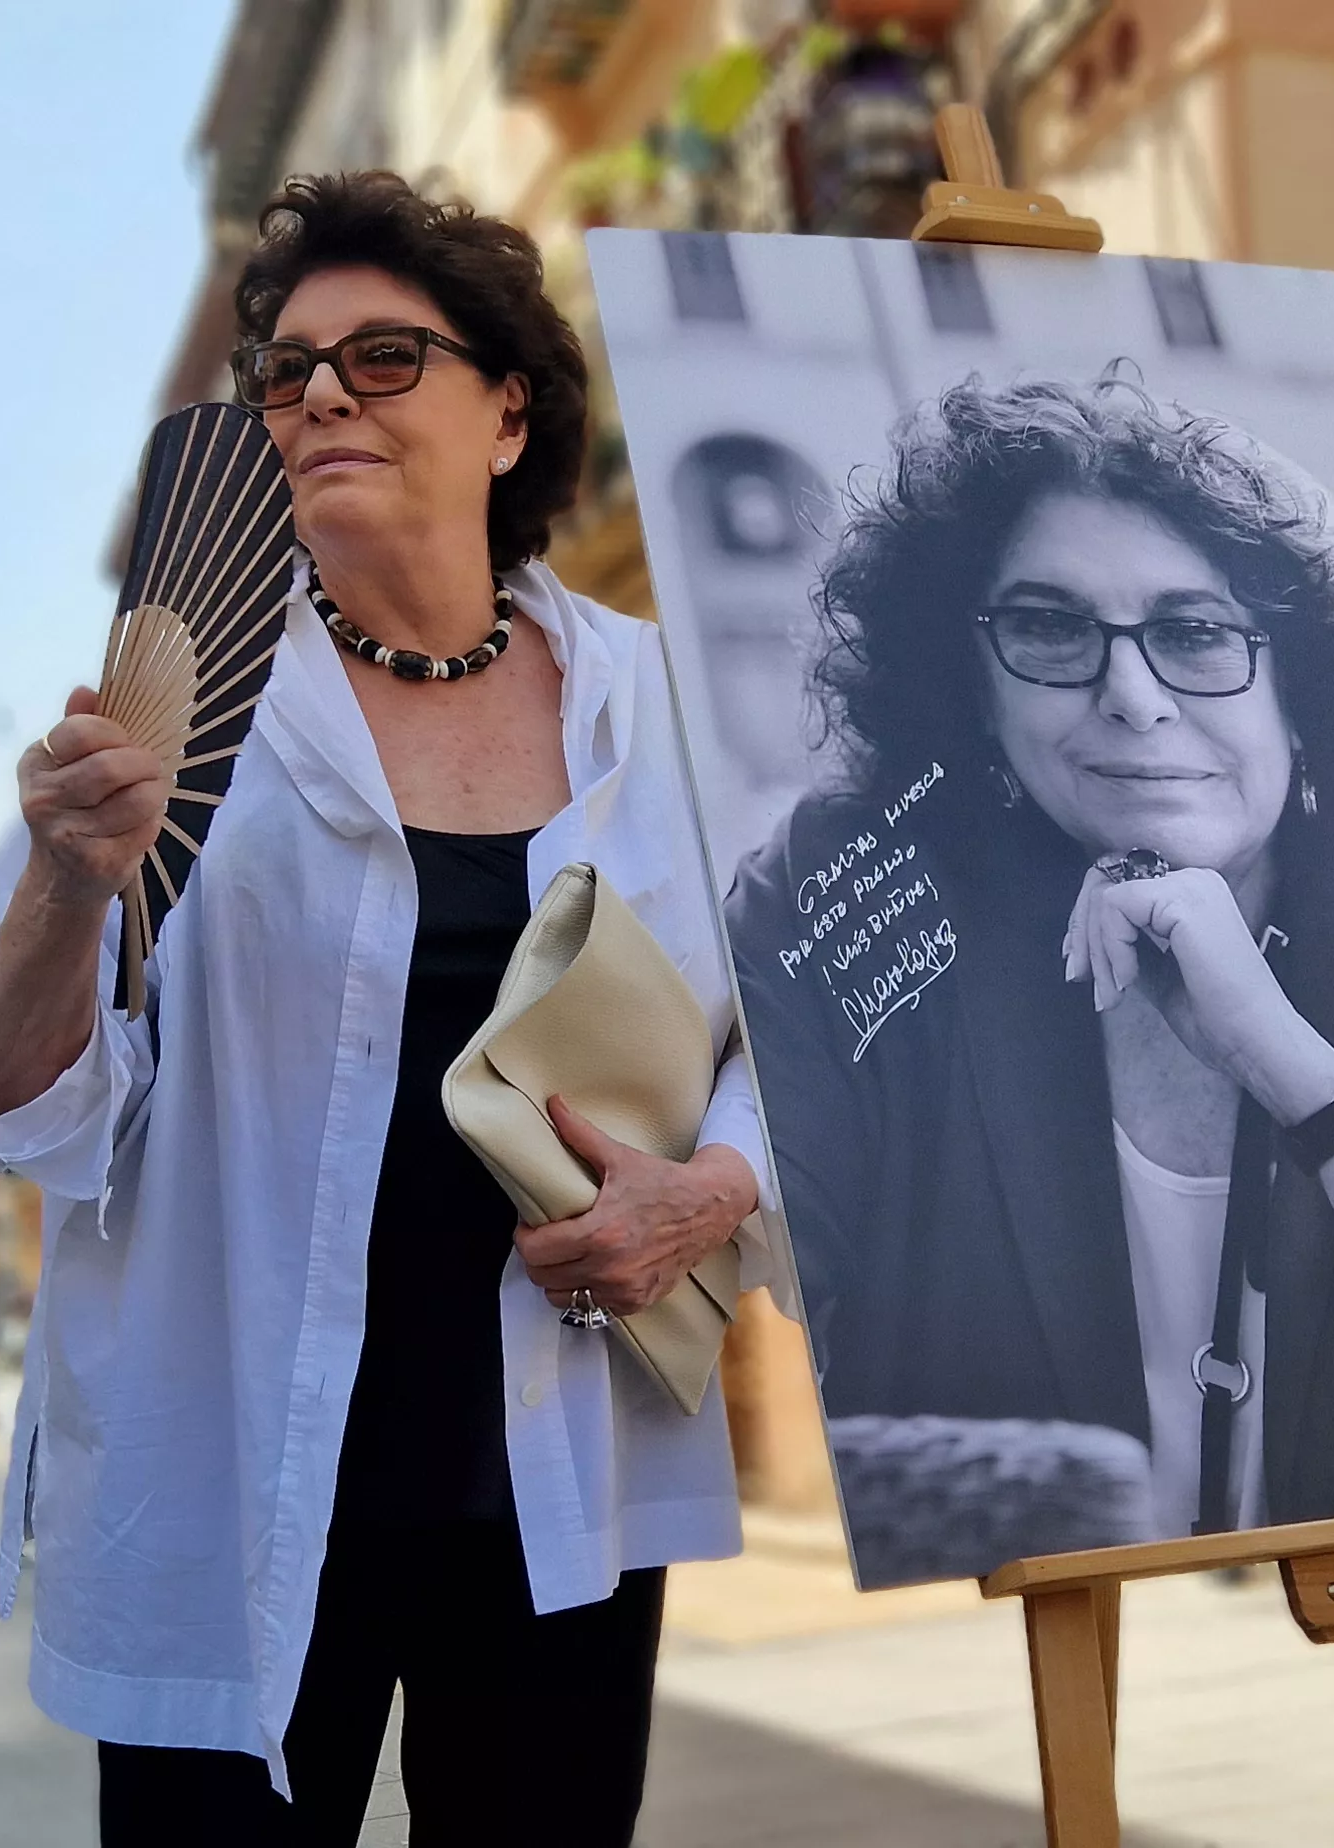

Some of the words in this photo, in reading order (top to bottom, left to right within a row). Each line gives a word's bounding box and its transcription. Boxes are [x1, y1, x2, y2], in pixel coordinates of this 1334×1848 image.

[884, 762, 945, 828] HUESCA
[813, 901, 847, 940] ESTE
[853, 845, 916, 903] PREMIO
